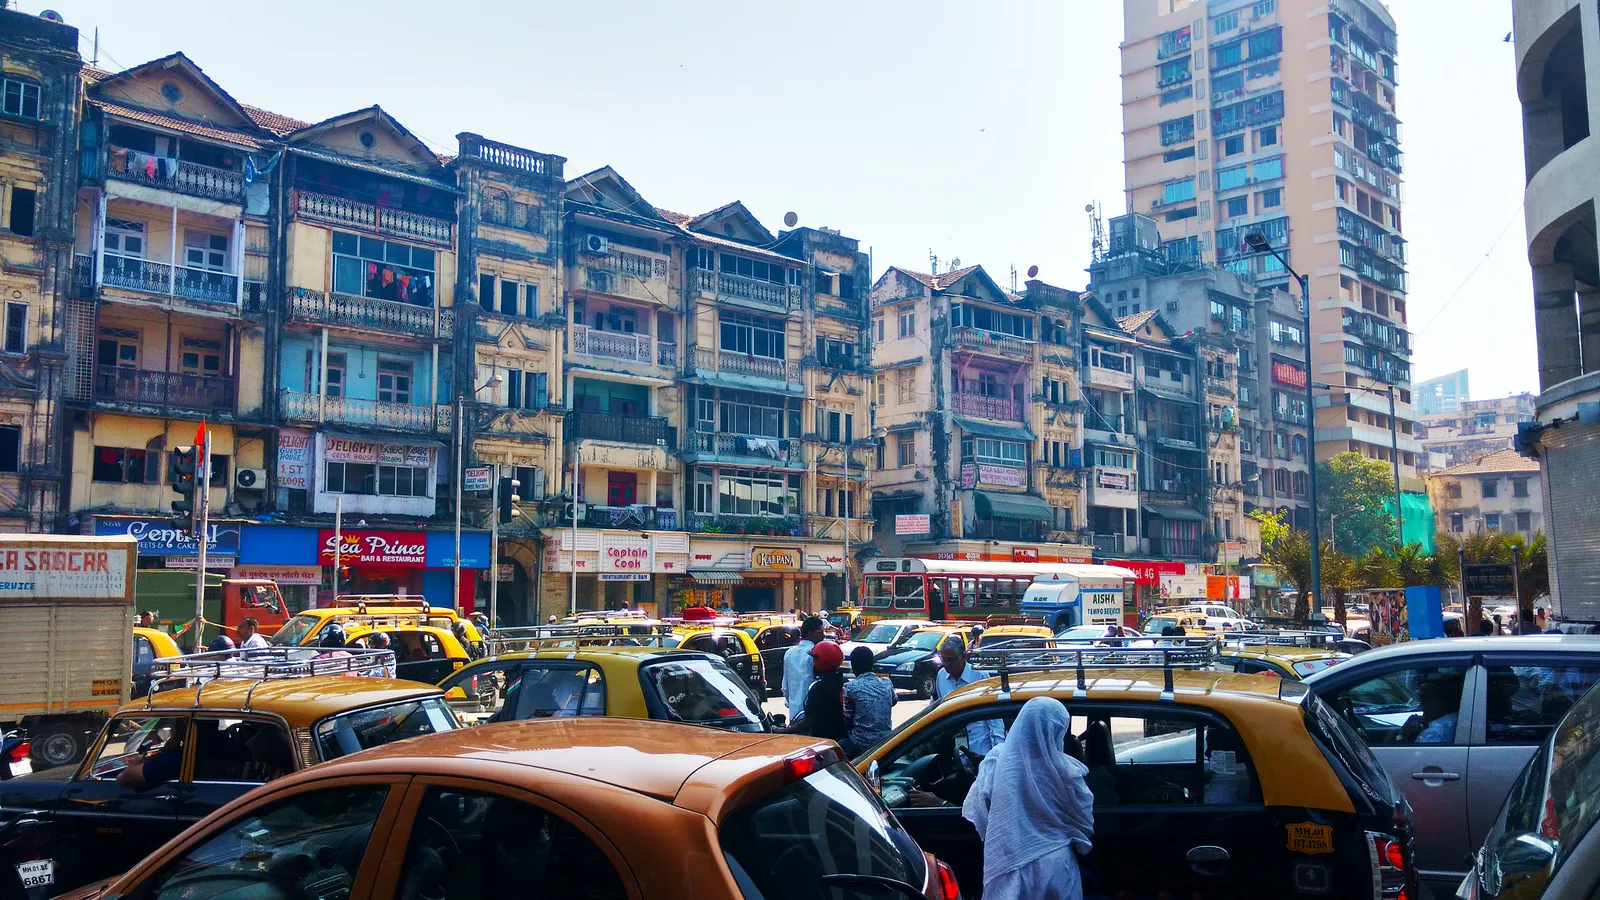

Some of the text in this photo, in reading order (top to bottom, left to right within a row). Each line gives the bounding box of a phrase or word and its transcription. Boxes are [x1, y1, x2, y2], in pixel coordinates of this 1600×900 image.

[177, 542, 196, 550] CAKE
[322, 535, 425, 555] Sea Prince
[607, 547, 648, 558] Captain
[614, 558, 641, 569] Cook
[761, 553, 795, 567] KALPANA
[1144, 568, 1154, 579] 4G
[1092, 594, 1116, 605] AISHA
[1294, 827, 1324, 836] MH.01
[24, 874, 51, 886] 6867
